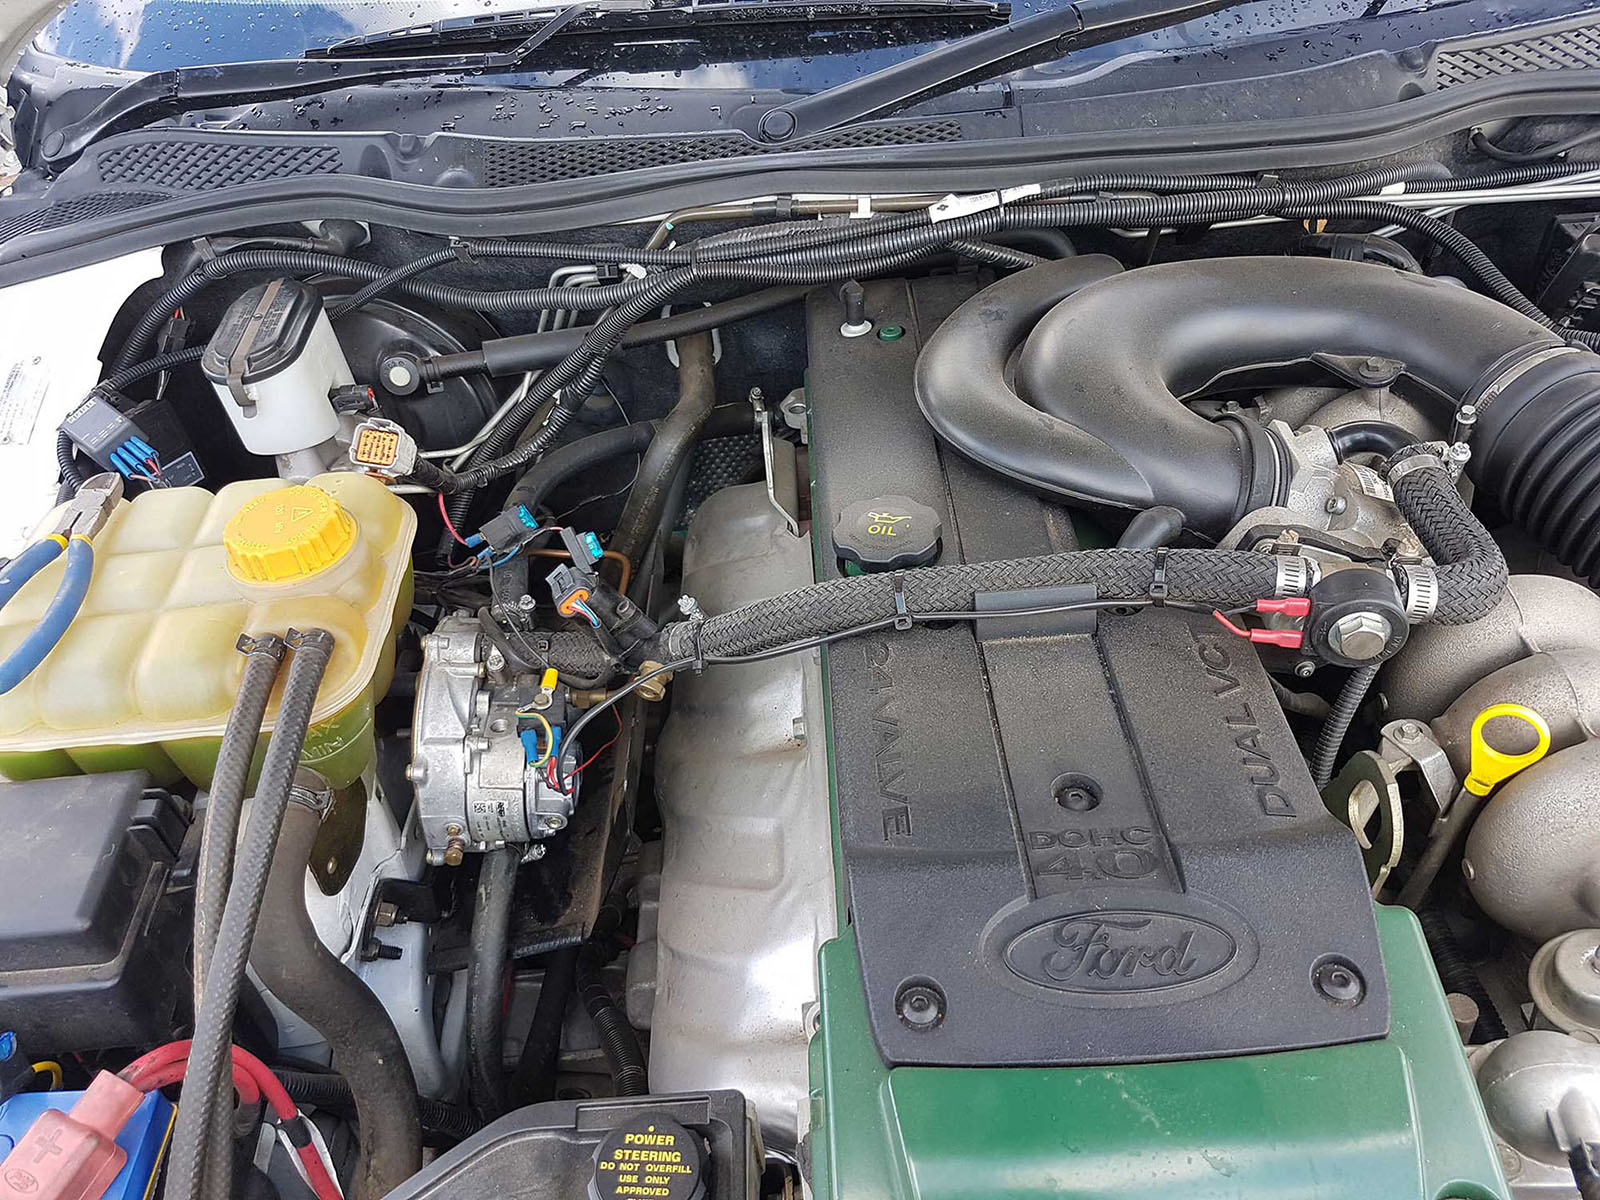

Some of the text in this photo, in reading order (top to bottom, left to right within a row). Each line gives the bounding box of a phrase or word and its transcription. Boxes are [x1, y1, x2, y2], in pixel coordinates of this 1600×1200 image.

[867, 524, 897, 536] OIL
[1226, 702, 1297, 818] DUAL
[871, 697, 913, 842] VALVE
[1028, 826, 1152, 850] DOHC
[1036, 849, 1160, 881] 4.0
[1042, 917, 1198, 983] Ford
[624, 1133, 675, 1146] POWER
[614, 1149, 682, 1162] STEERING
[600, 1161, 693, 1174] DO NOT OVERFILL
[619, 1174, 670, 1185] USE ONLY
[615, 1185, 670, 1196] APPROVED
